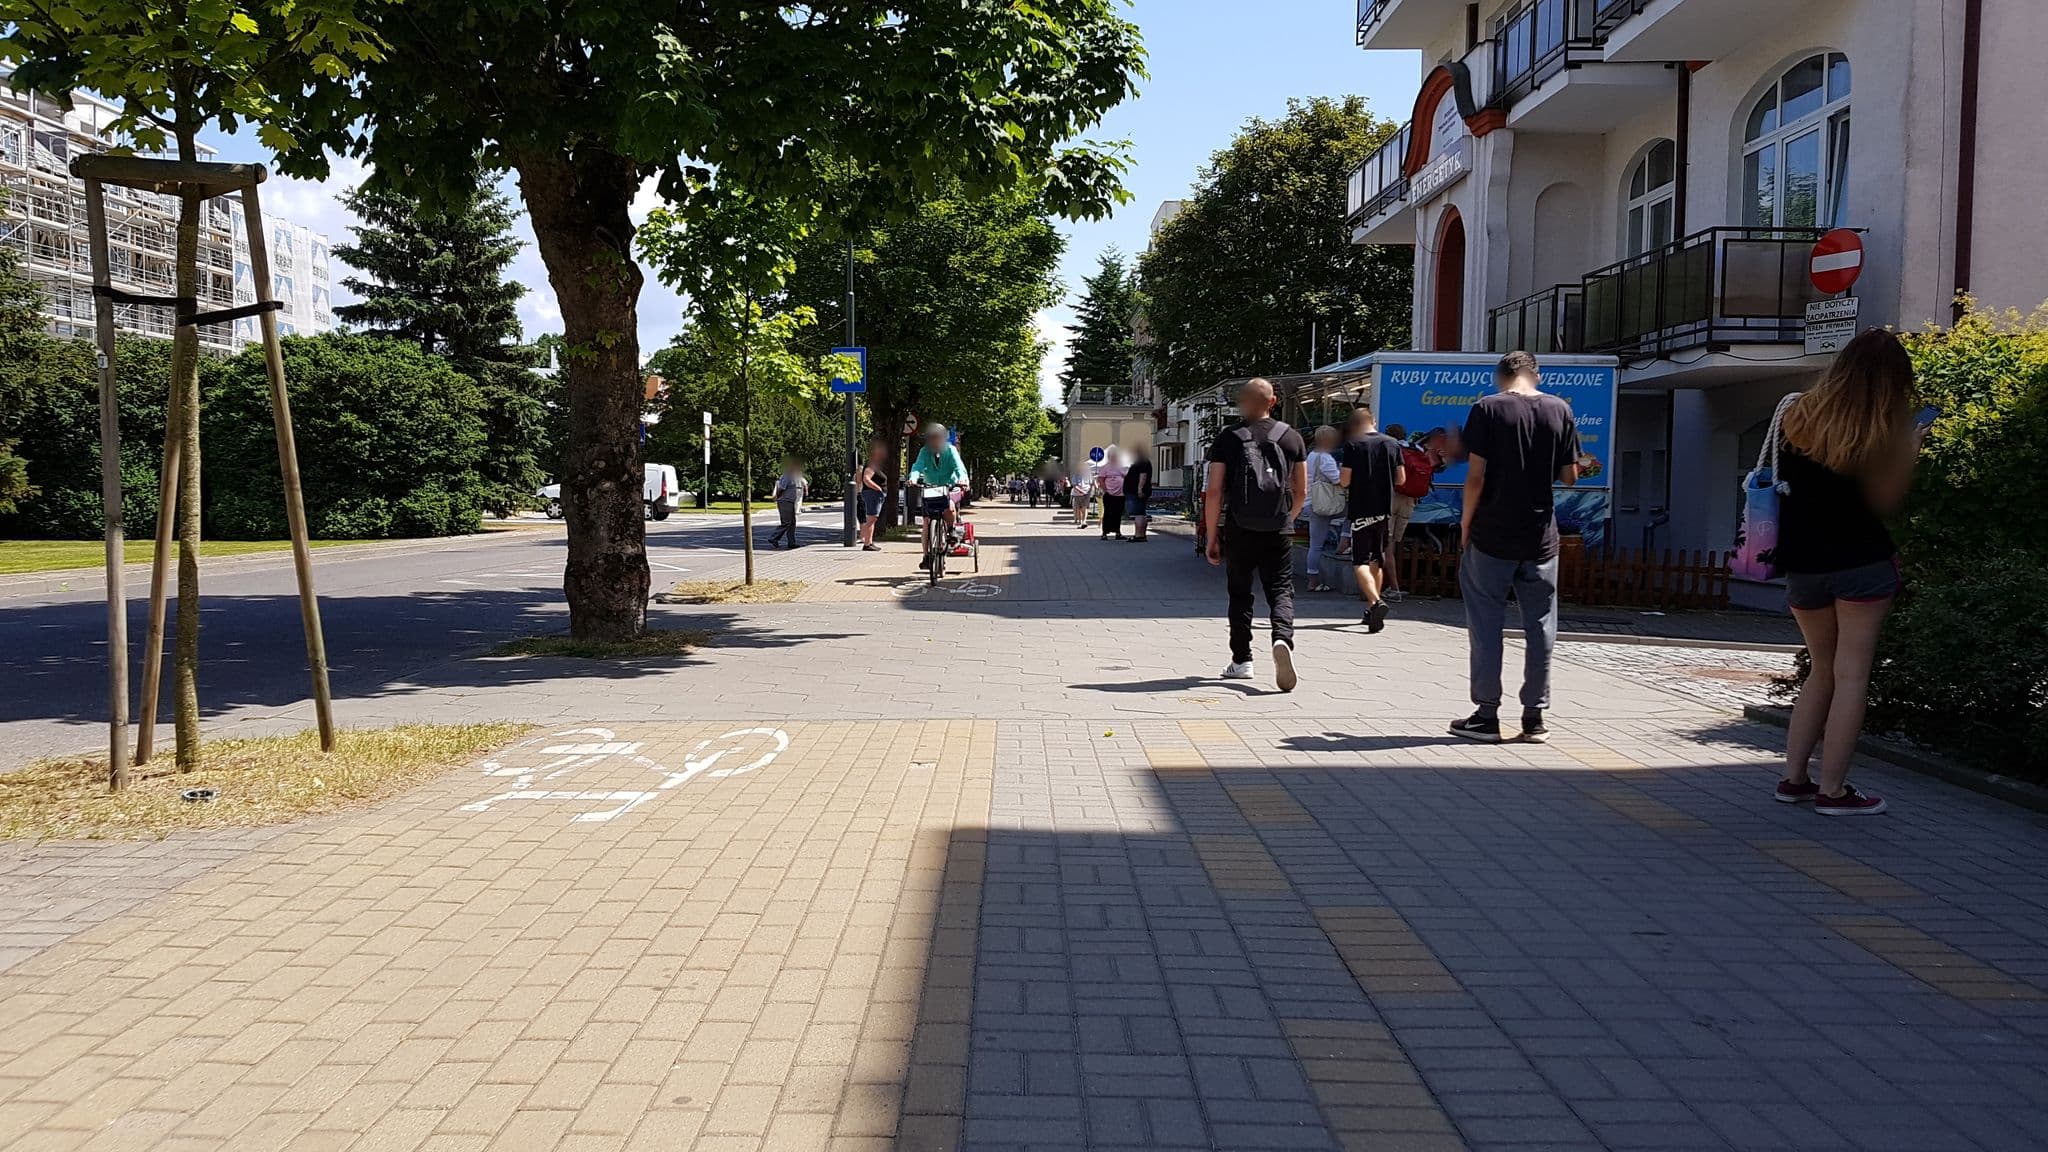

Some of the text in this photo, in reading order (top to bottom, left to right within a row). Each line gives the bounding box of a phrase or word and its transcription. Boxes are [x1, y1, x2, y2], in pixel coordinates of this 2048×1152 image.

[1809, 299, 1855, 311] NIE DOTYCZY
[1806, 309, 1856, 321] ZAOPATRZENIA
[1391, 370, 1430, 386] RYBY
